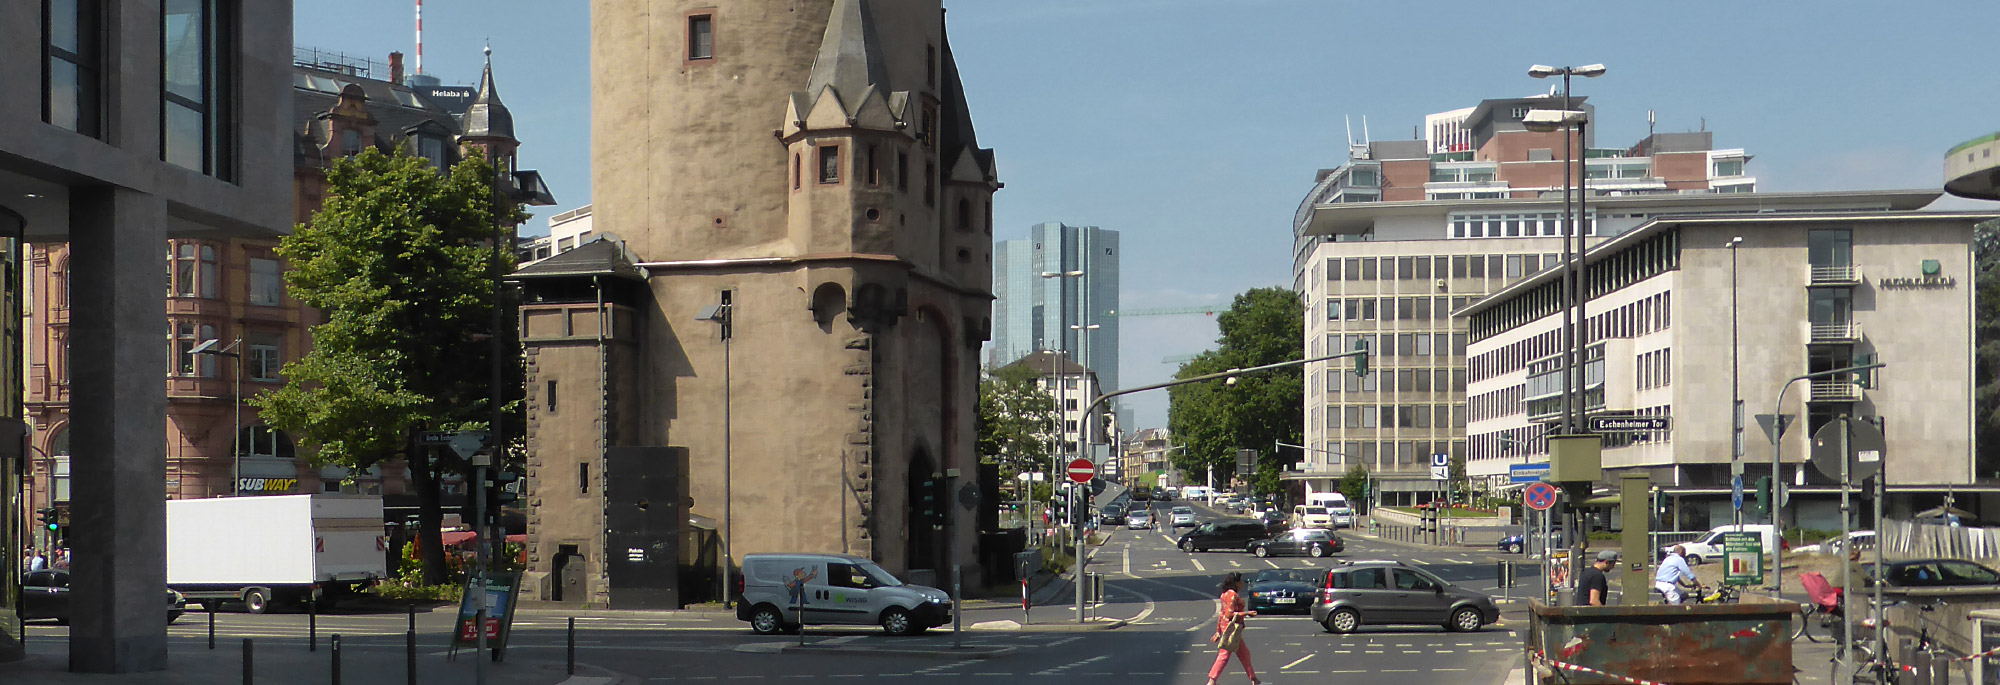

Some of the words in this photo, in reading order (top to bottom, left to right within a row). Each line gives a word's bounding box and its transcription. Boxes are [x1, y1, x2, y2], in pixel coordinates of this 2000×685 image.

[1599, 420, 1649, 429] Eschenheimer
[1652, 420, 1664, 428] Tor
[1434, 454, 1447, 465] U
[237, 478, 297, 491] SUBWAY
